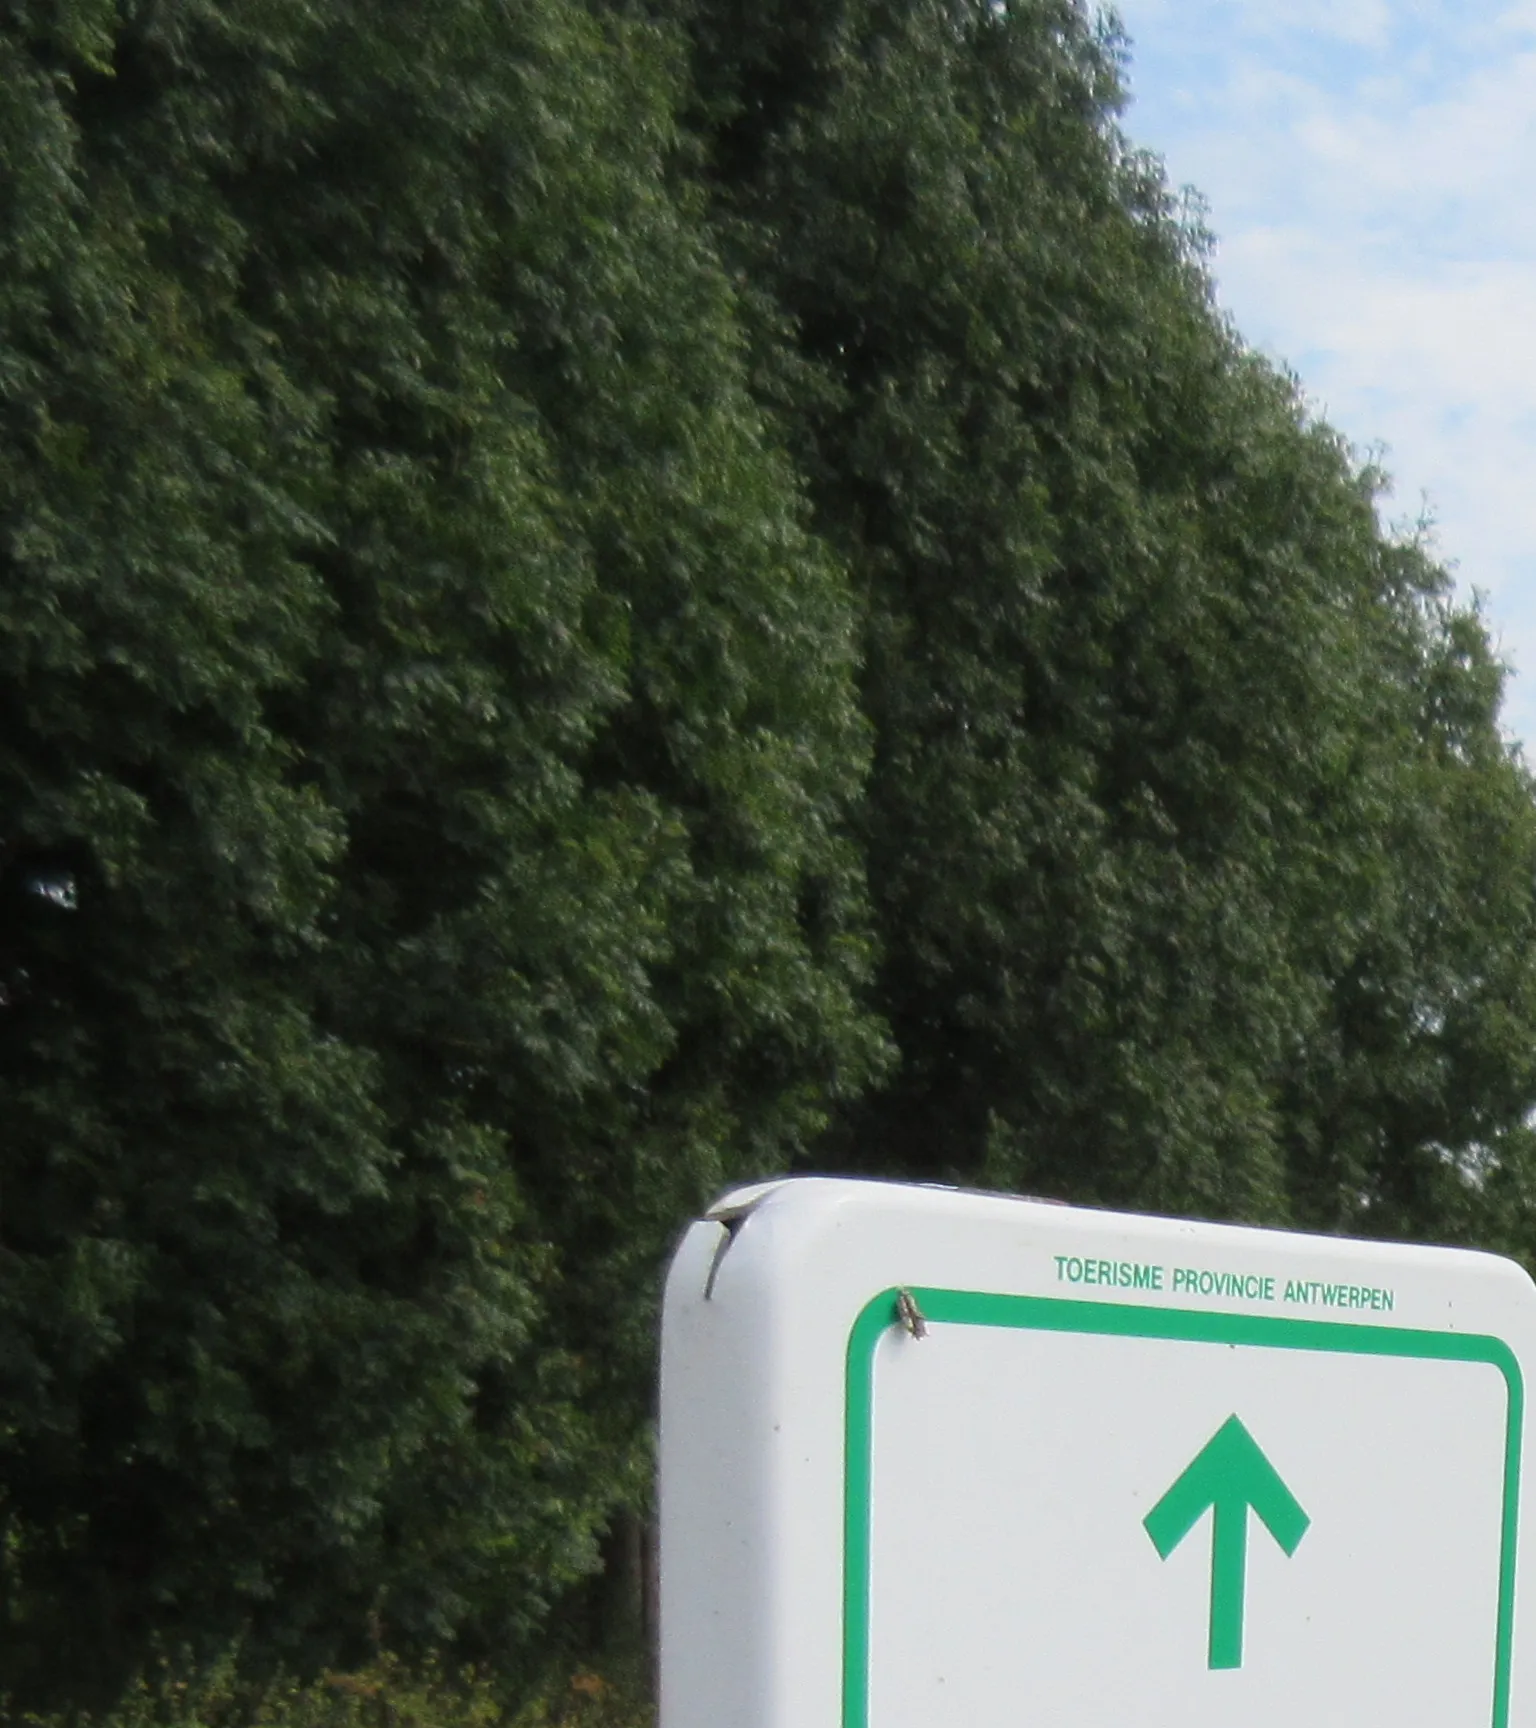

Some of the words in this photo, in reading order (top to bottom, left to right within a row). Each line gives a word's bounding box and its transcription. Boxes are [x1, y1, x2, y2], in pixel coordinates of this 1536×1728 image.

[1054, 1256, 1164, 1290] TOERISME
[1173, 1268, 1275, 1300] PROVINCIE
[1284, 1280, 1394, 1311] ANTWERPEN
